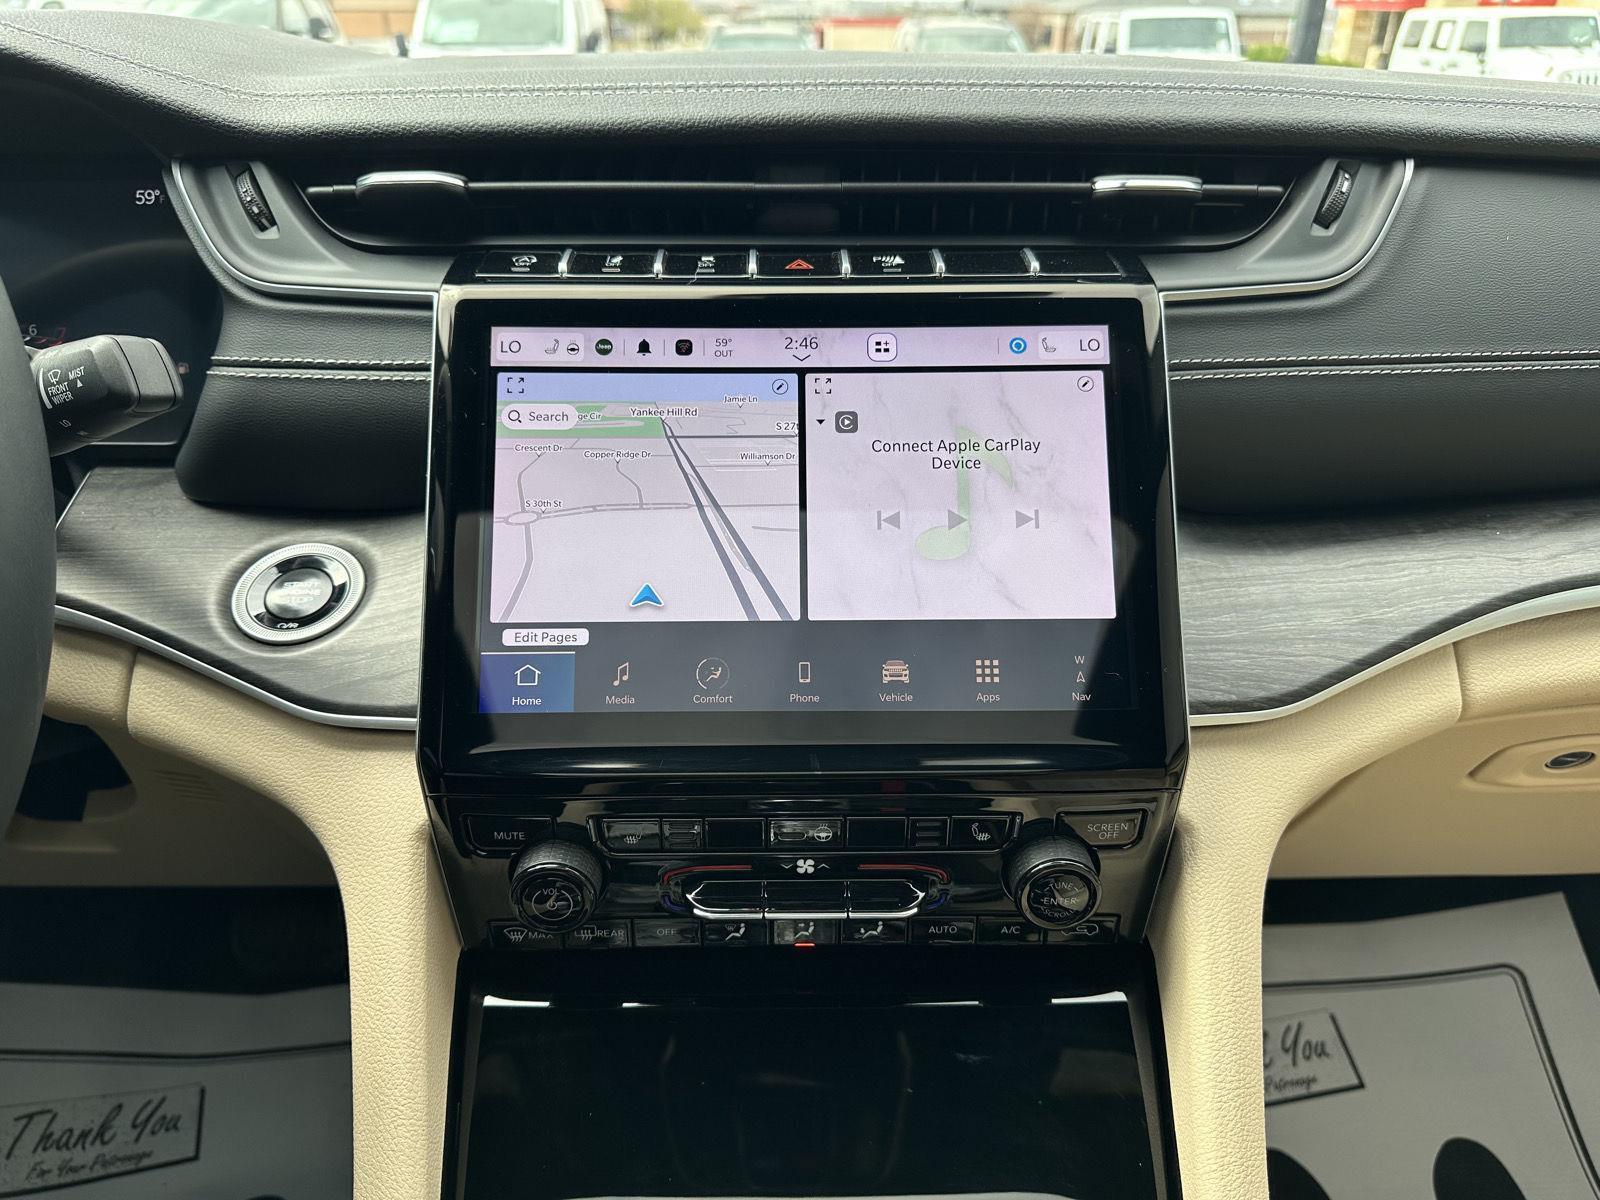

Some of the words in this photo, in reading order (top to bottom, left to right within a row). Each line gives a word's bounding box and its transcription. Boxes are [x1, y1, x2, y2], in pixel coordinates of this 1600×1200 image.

[29, 324, 38, 336] 6
[499, 340, 521, 353] LO
[715, 338, 733, 347] 59°
[784, 336, 819, 350] 2:46
[1079, 338, 1101, 351] LO
[714, 350, 733, 358] OUT
[68, 366, 84, 380] MIST
[47, 381, 69, 397] FRONT
[51, 391, 74, 405] WIPER
[723, 395, 747, 404] Jamie
[748, 395, 758, 403] Ln
[528, 411, 569, 422] Search
[590, 412, 602, 420] Cir
[630, 407, 665, 417] Yankee
[666, 407, 683, 417] Hill
[685, 407, 699, 417] Rd
[775, 422, 782, 431] S
[514, 443, 552, 452] Crescent
[553, 444, 563, 452] Dr
[871, 439, 933, 453] Connect
[937, 439, 981, 455] Apple
[984, 438, 1041, 454] CarPlay
[584, 451, 614, 460] Copper
[616, 450, 640, 460] Ridge
[641, 450, 652, 459] Dr
[740, 452, 784, 460] Williamson
[785, 452, 796, 460] Dr
[932, 457, 981, 470] Device
[525, 500, 531, 508] S
[533, 500, 551, 508] 30th
[553, 500, 563, 508] St
[514, 632, 539, 643] Edit
[541, 632, 577, 644] Pages
[1074, 655, 1085, 664] W
[511, 696, 542, 706] Home
[605, 694, 635, 704] Media
[693, 693, 733, 704] Comfort
[789, 693, 820, 703] Phone
[878, 693, 913, 702] Vehicle
[976, 693, 1000, 704] Apps
[1072, 692, 1091, 702] Nav
[1087, 822, 1129, 832] SCREEN
[494, 831, 526, 841] MUTE
[1098, 831, 1120, 840] OFF
[1048, 881, 1073, 890] TUNE
[543, 888, 560, 896] VOL
[596, 929, 625, 937] REAR
[656, 928, 677, 936] OFF
[928, 925, 958, 934] AUTO
[1000, 925, 1021, 934] A/C
[1280, 1020, 1330, 1067] You
[5, 1102, 123, 1160] Thank
[131, 1095, 182, 1144] You
